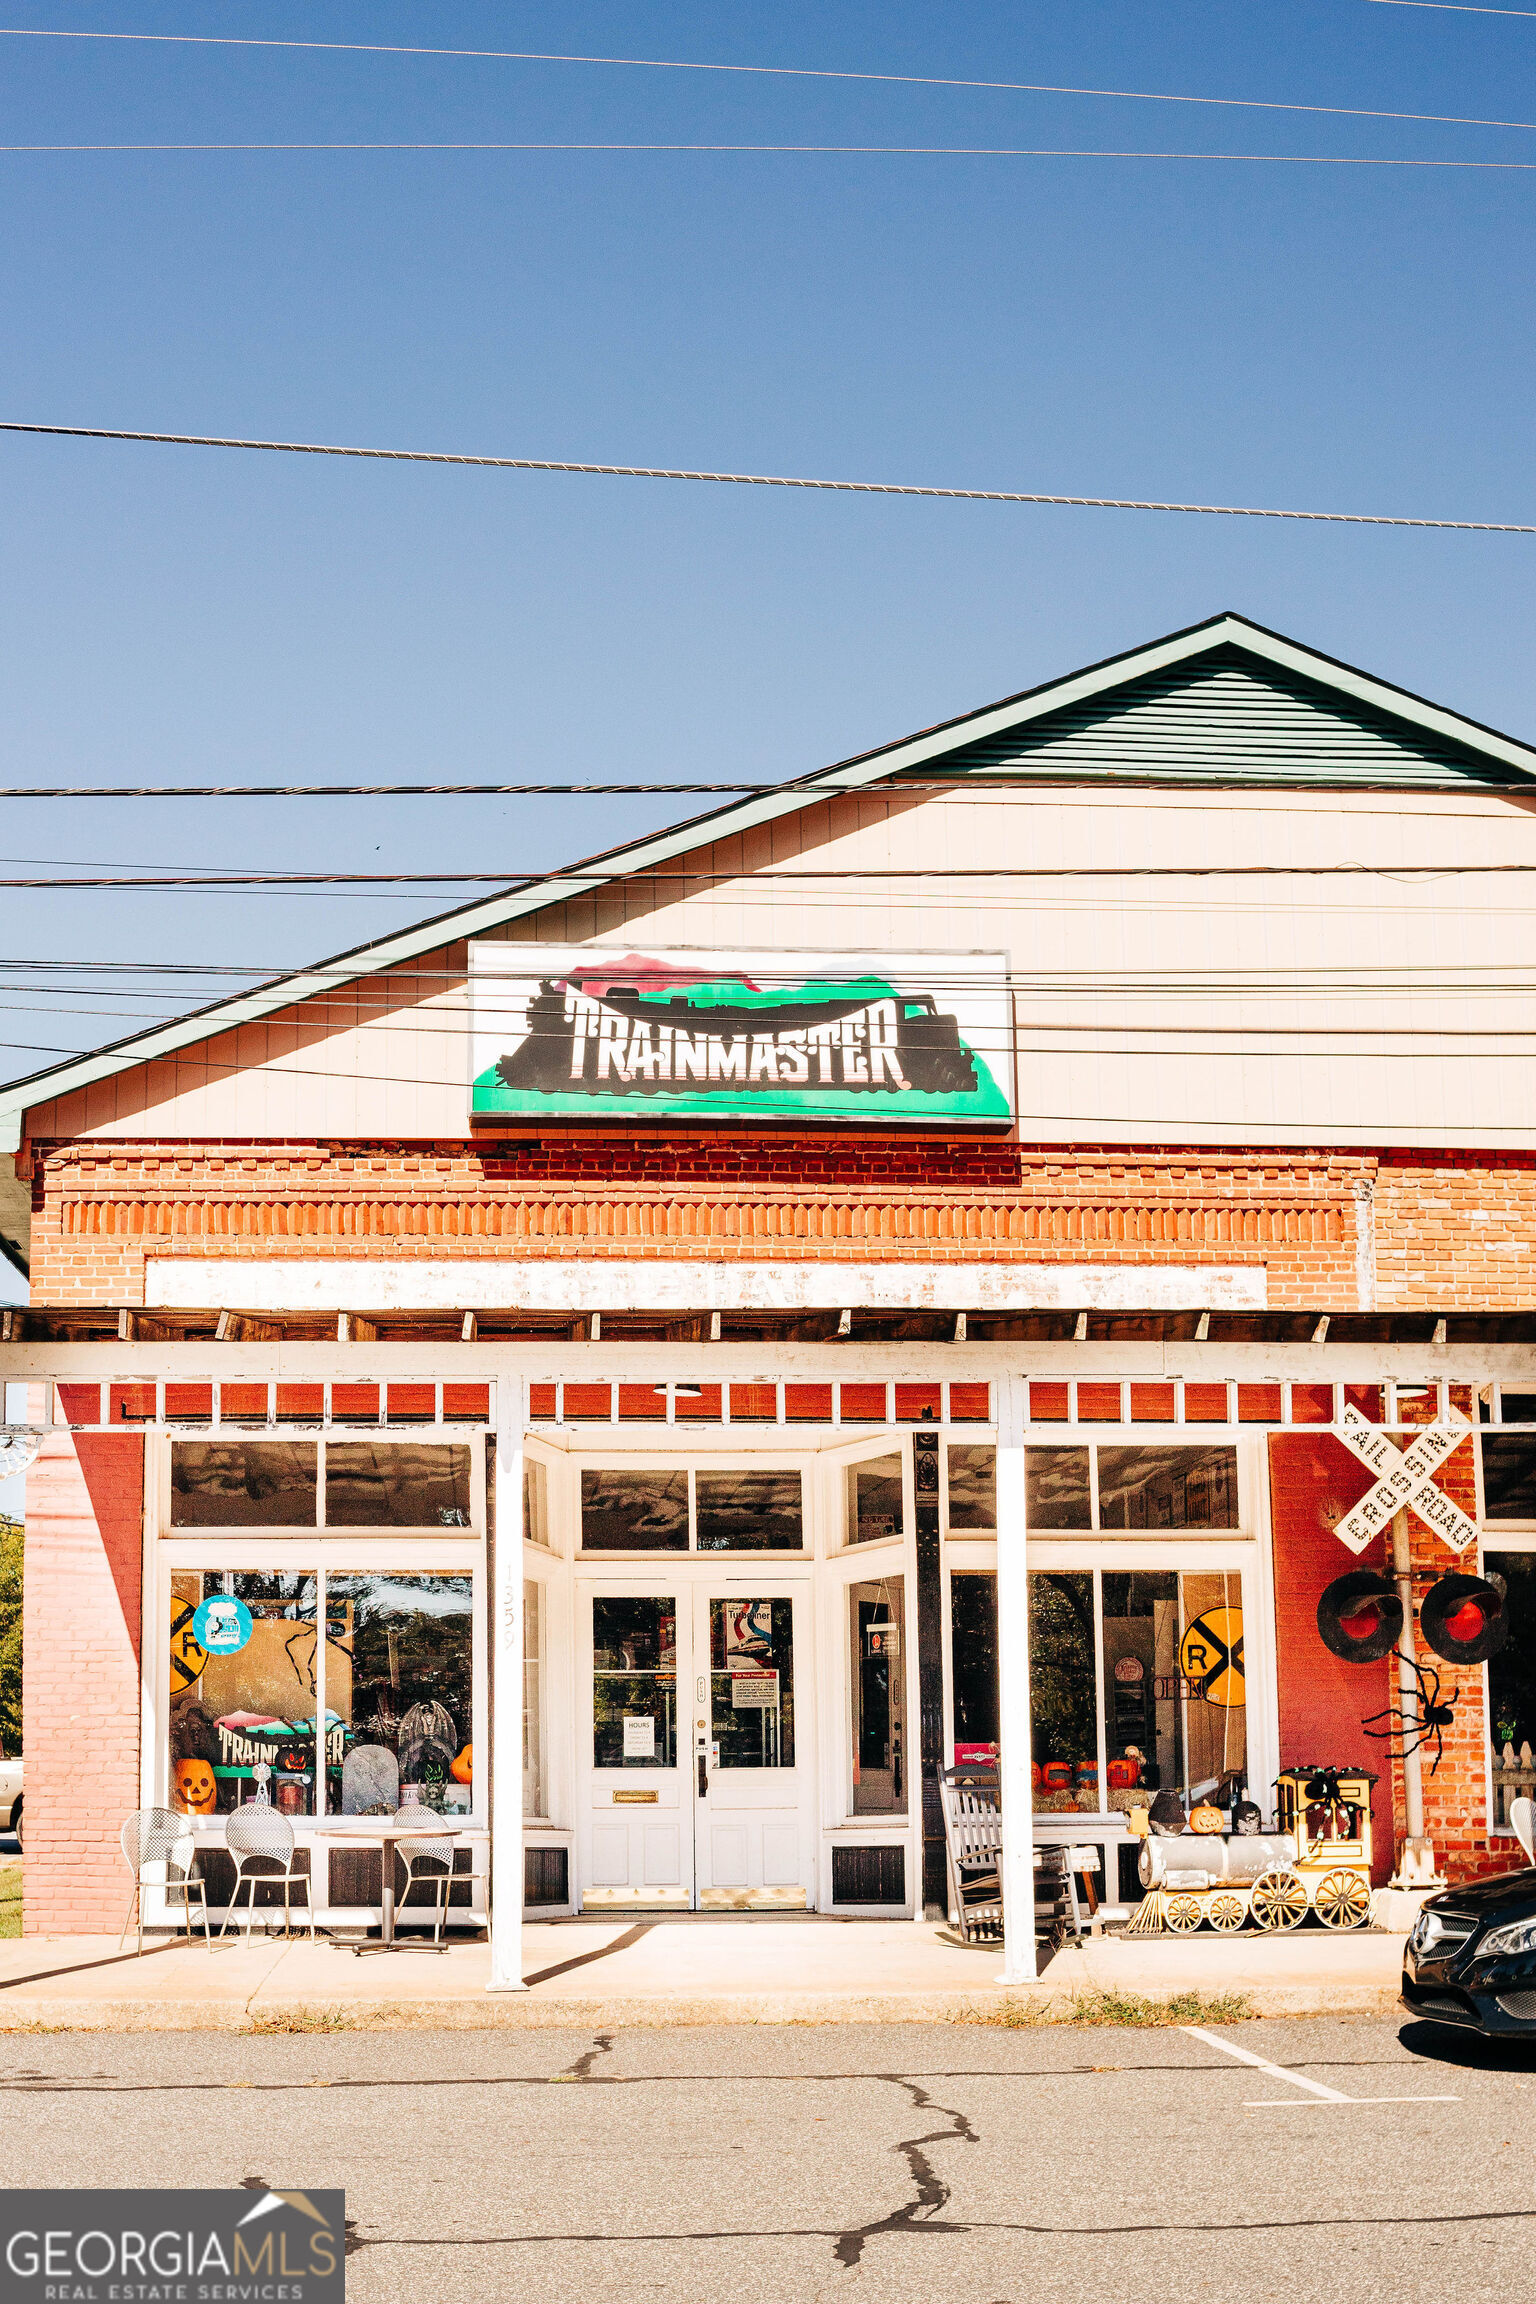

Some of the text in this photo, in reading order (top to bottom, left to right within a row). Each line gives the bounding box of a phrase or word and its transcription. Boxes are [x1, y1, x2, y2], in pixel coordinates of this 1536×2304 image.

[563, 983, 911, 1090] TRAINMASTER
[1413, 1485, 1473, 1546] ROAD
[728, 1610, 770, 1619] Turboliner
[182, 1632, 203, 1657] R
[1187, 1645, 1208, 1669] R
[1153, 1676, 1206, 1700] OPEN
